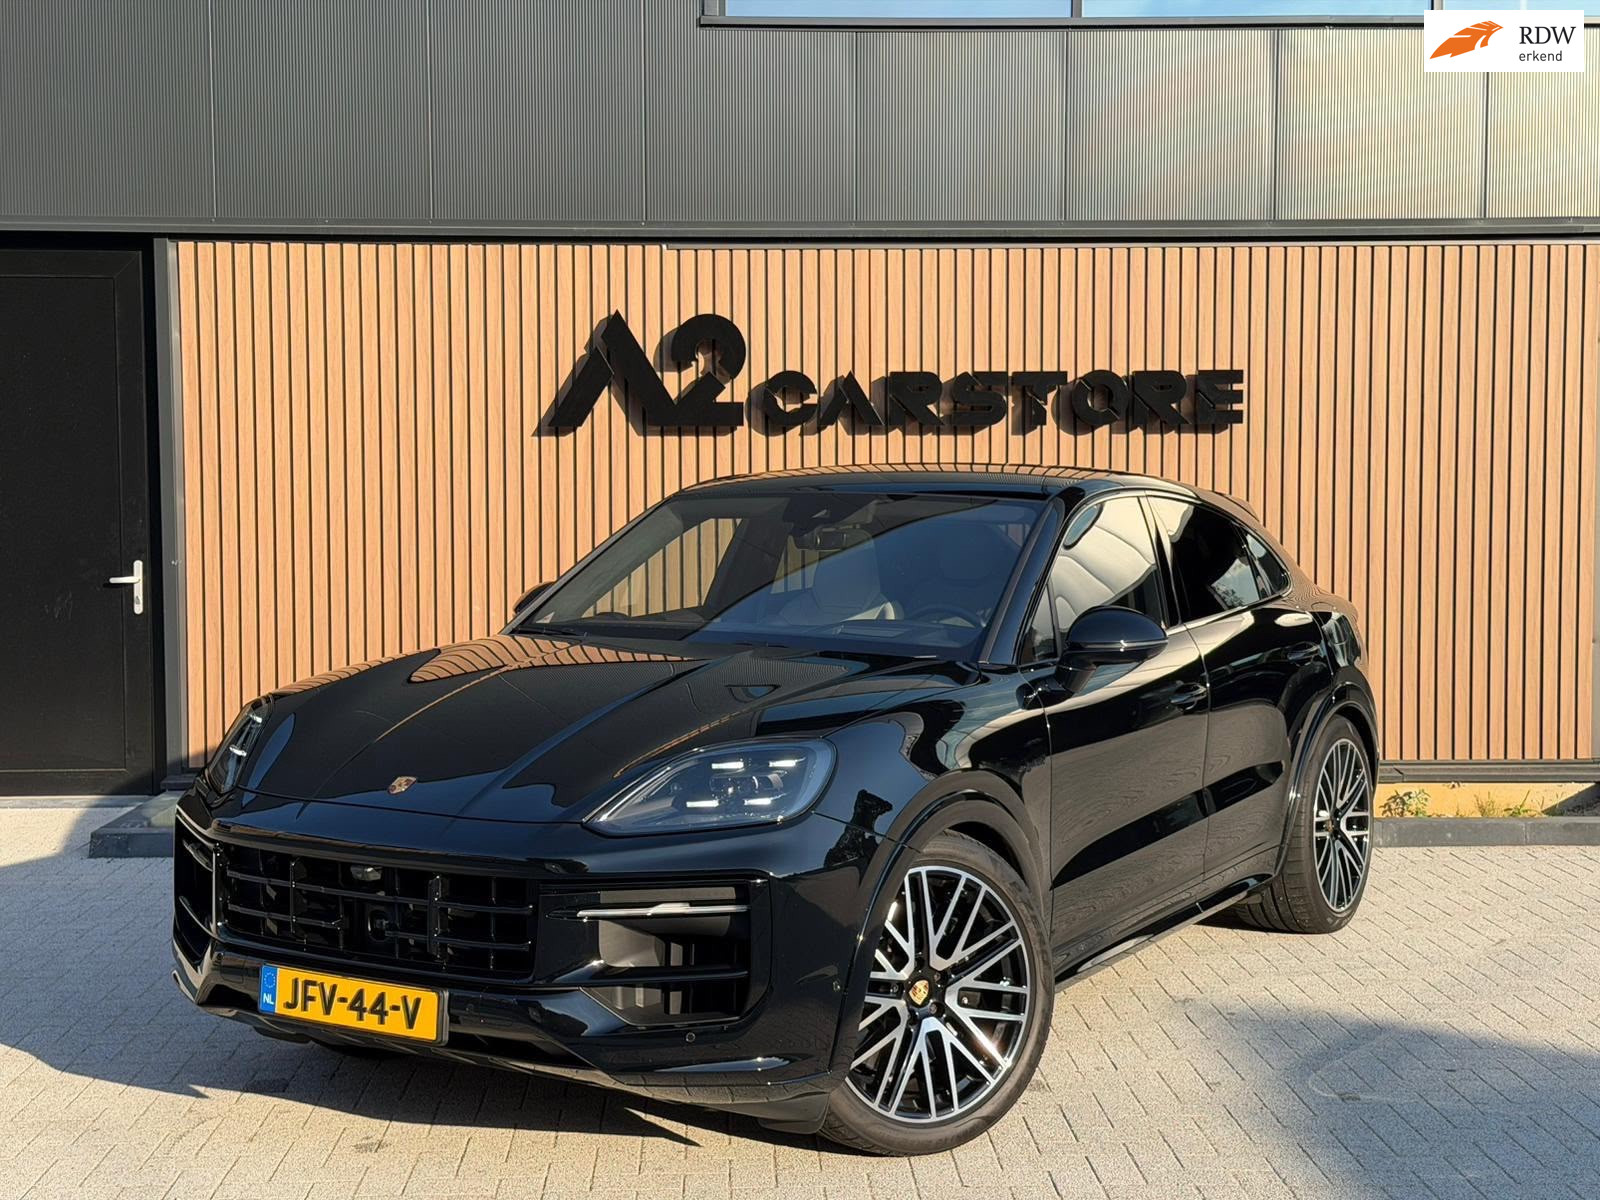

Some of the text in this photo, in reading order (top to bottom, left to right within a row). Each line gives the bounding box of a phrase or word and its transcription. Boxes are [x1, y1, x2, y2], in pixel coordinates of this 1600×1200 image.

[547, 309, 1244, 427] A2 CARSTORE
[263, 993, 274, 1005] NL
[283, 977, 422, 1030] JFV-44-V
